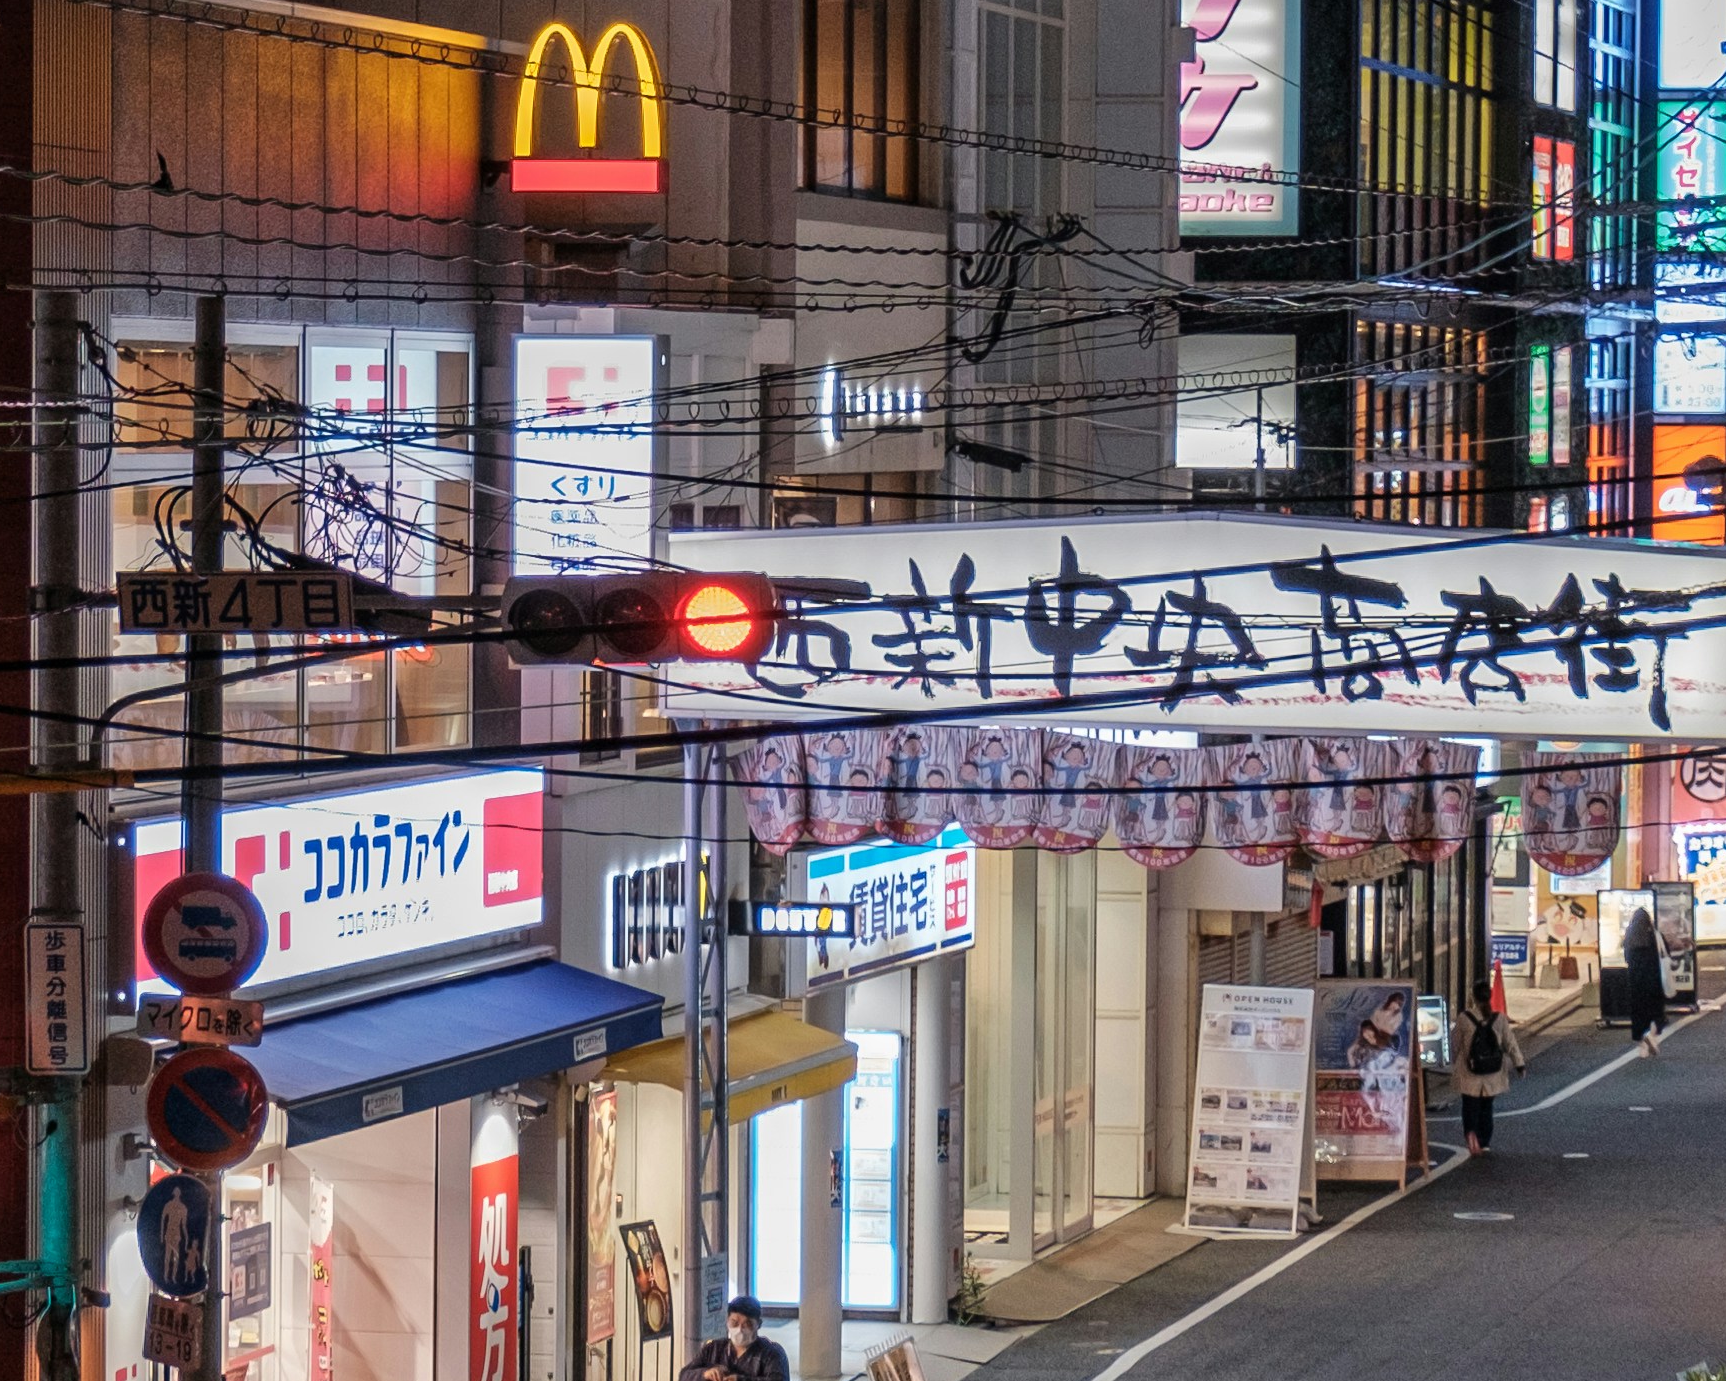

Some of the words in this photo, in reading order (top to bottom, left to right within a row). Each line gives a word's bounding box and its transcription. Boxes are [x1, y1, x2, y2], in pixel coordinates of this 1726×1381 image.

[551, 475, 616, 500] くすり
[130, 579, 341, 629] 西新4丁目
[304, 810, 469, 903] ココカラファイン
[849, 868, 927, 951] 賃貸住宅
[44, 930, 69, 1066] 歩車分離信号
[144, 1002, 256, 1038] マイクロを除く
[1233, 995, 1261, 1004] OPEN
